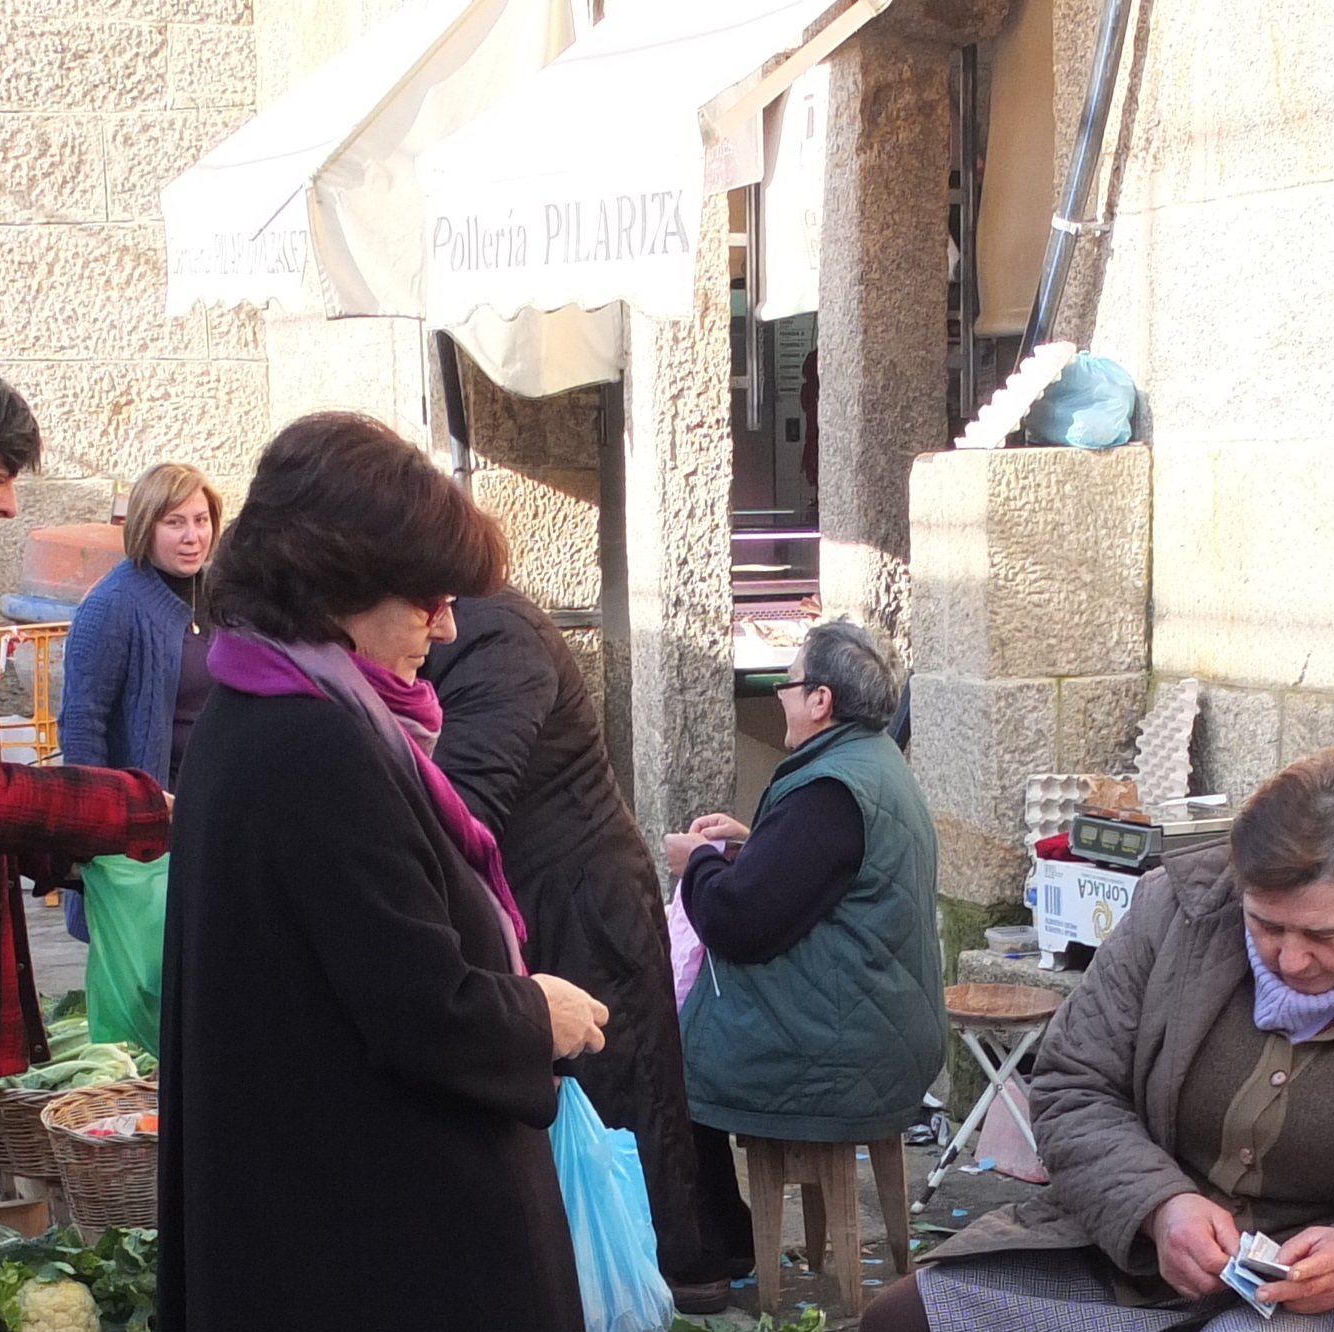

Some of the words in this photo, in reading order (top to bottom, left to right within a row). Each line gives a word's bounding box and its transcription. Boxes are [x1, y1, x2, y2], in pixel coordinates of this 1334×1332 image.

[433, 208, 527, 271] Pollería
[543, 189, 690, 265] PILARITA
[1078, 877, 1129, 909] COPLACA
